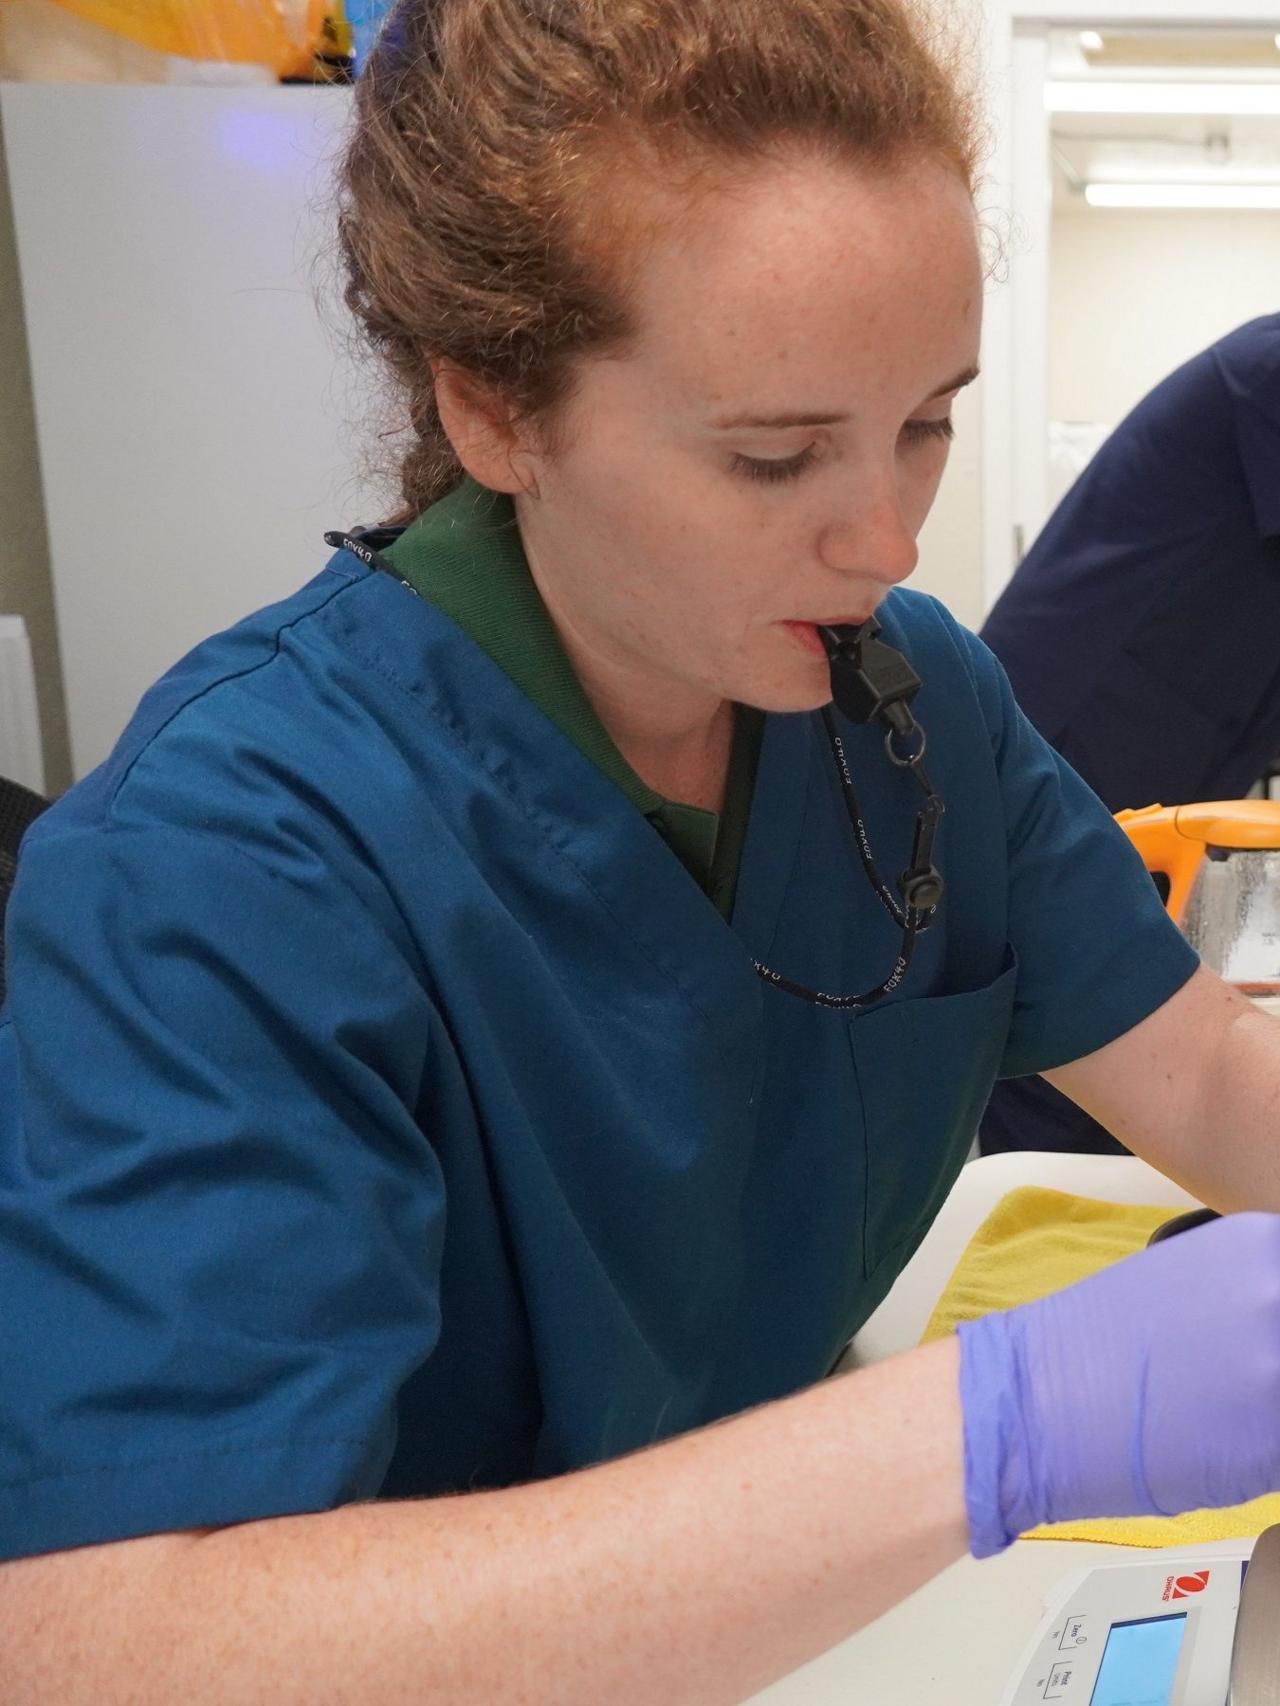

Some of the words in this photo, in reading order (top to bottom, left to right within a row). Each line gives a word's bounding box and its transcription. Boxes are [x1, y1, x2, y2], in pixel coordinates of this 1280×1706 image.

[882, 955, 907, 993] FOX40
[1162, 1575, 1175, 1602] OHAUS
[1071, 1624, 1082, 1638] Zero
[1060, 1671, 1072, 1686] Print
